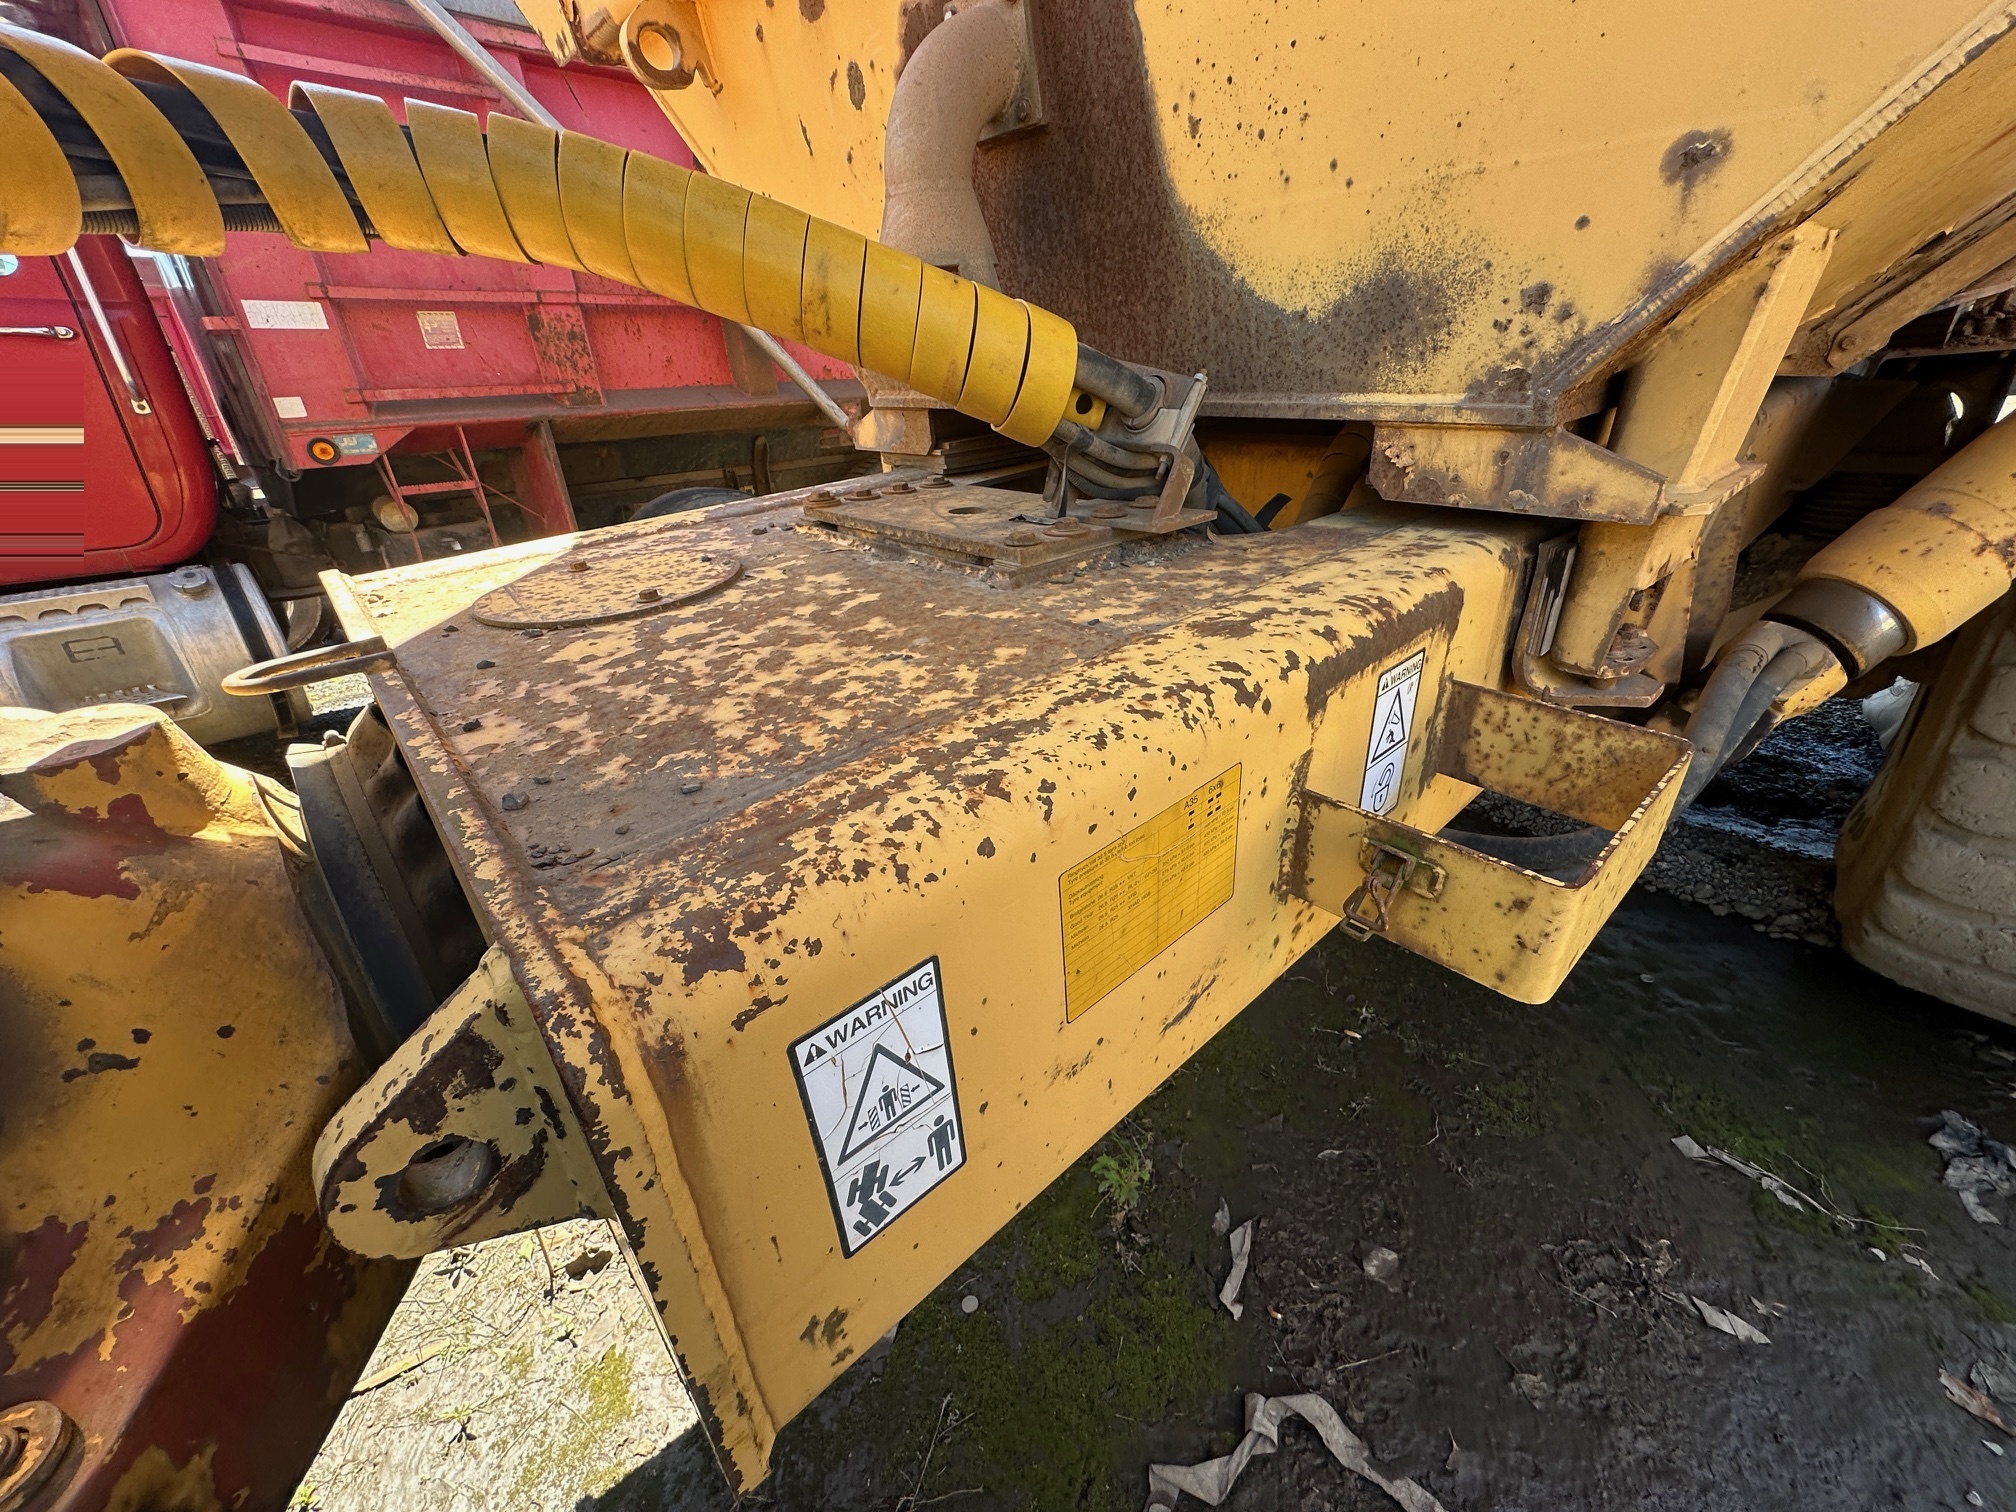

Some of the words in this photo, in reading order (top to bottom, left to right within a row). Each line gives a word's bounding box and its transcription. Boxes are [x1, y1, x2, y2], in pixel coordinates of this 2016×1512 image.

[1391, 658, 1421, 686] WARNING
[1184, 795, 1198, 810] A35
[825, 971, 934, 1049] WARNING
